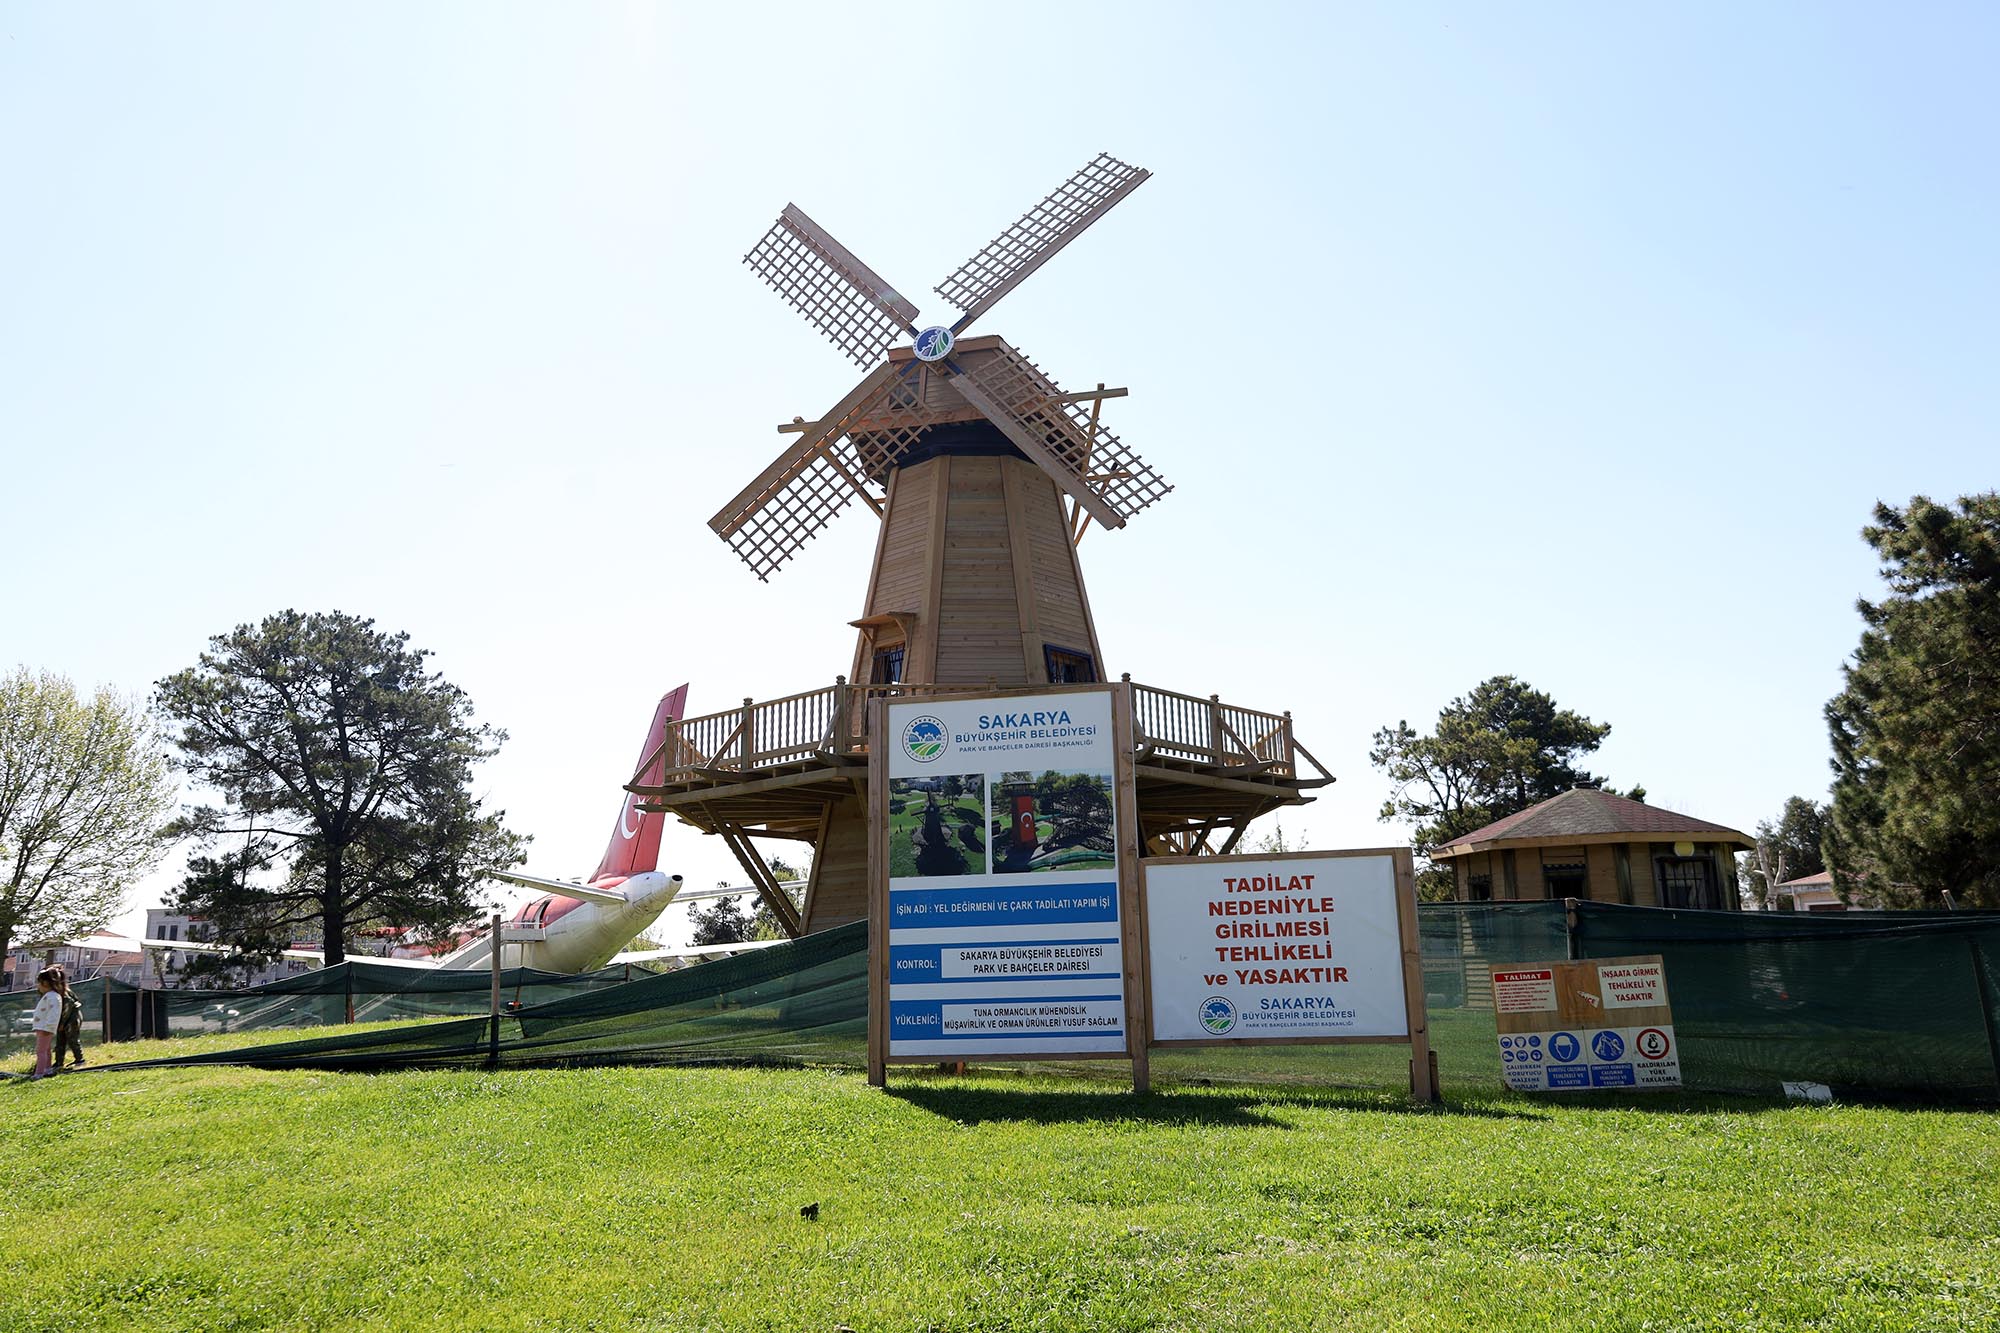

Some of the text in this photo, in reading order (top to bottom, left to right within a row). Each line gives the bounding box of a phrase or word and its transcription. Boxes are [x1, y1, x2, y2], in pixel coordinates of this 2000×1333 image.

[979, 710, 1071, 729] SAKARYA
[955, 726, 1096, 743] BÜYÜKŞEHİR BELEDİYESİ
[988, 744, 1024, 752] BAHÇELER
[1025, 741, 1051, 749] DAİRESİ
[1052, 740, 1093, 749] BAŞKANLIĞI
[1224, 873, 1314, 893] TADİLAT
[896, 903, 911, 915] İŞİN
[914, 905, 927, 913] ADI
[934, 904, 948, 913] YEL
[952, 901, 995, 913] DEĞİRMENİ
[997, 902, 1007, 911] VE
[1010, 901, 1033, 912] ÇARK
[1035, 898, 1070, 910] TADİLATI
[1073, 898, 1097, 908] YAPIM
[1099, 896, 1110, 908] İŞİ
[1209, 896, 1334, 916] NEDENİYLE
[1216, 917, 1329, 939] GİRİLMESİ
[960, 945, 1102, 961] SAKARYA BÜYÜKŞEHİR BELEDİYESİ
[1215, 941, 1332, 962] TEHLİKELİ
[896, 960, 937, 969] KONTROL:
[973, 960, 1089, 974] PARK VE BAHÇELER DAİRESİ
[1204, 967, 1348, 985] ve YASAKTIR
[1504, 973, 1541, 981] TALİMAT
[1602, 966, 1659, 979] İNŞAATA GİRMEK
[1608, 979, 1644, 989] TEHLİKELİ
[1261, 997, 1335, 1010] SAKARYA
[1615, 993, 1653, 1001] YASAKTIR
[973, 1005, 1086, 1017] TUNA ORMANCILIK MÜHENDİSLİK
[1242, 1010, 1356, 1021] BÜYÜKŞEHİR BELEDİYESİ
[895, 1013, 940, 1025] YÜKLENİCİ:
[944, 1015, 1117, 1031] MÜŞAVİRLİK VE ORMAN ÜRÜNLERİ YUSUF SAĞLAM
